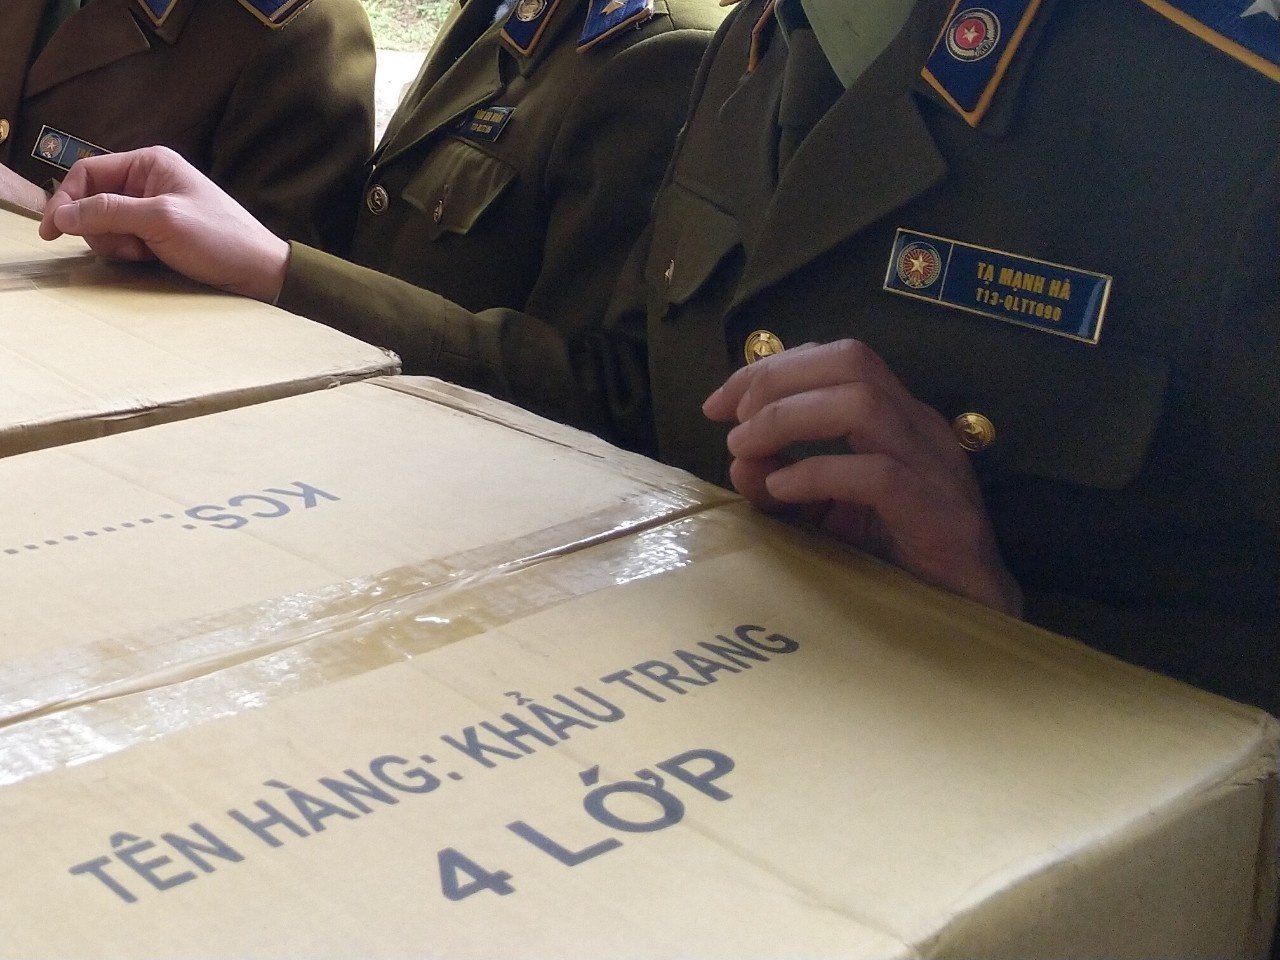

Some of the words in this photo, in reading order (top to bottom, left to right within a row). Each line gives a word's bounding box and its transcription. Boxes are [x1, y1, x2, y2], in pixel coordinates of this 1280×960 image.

[977, 262, 995, 284] TẠ
[998, 267, 1047, 294] MẠNH
[69, 823, 245, 904] TÊN
[227, 753, 465, 848] HÀNG:
[440, 691, 626, 769] KHẨU
[601, 624, 801, 703] TRANG
[437, 847, 517, 901] 4
[506, 747, 736, 867] LỚP
